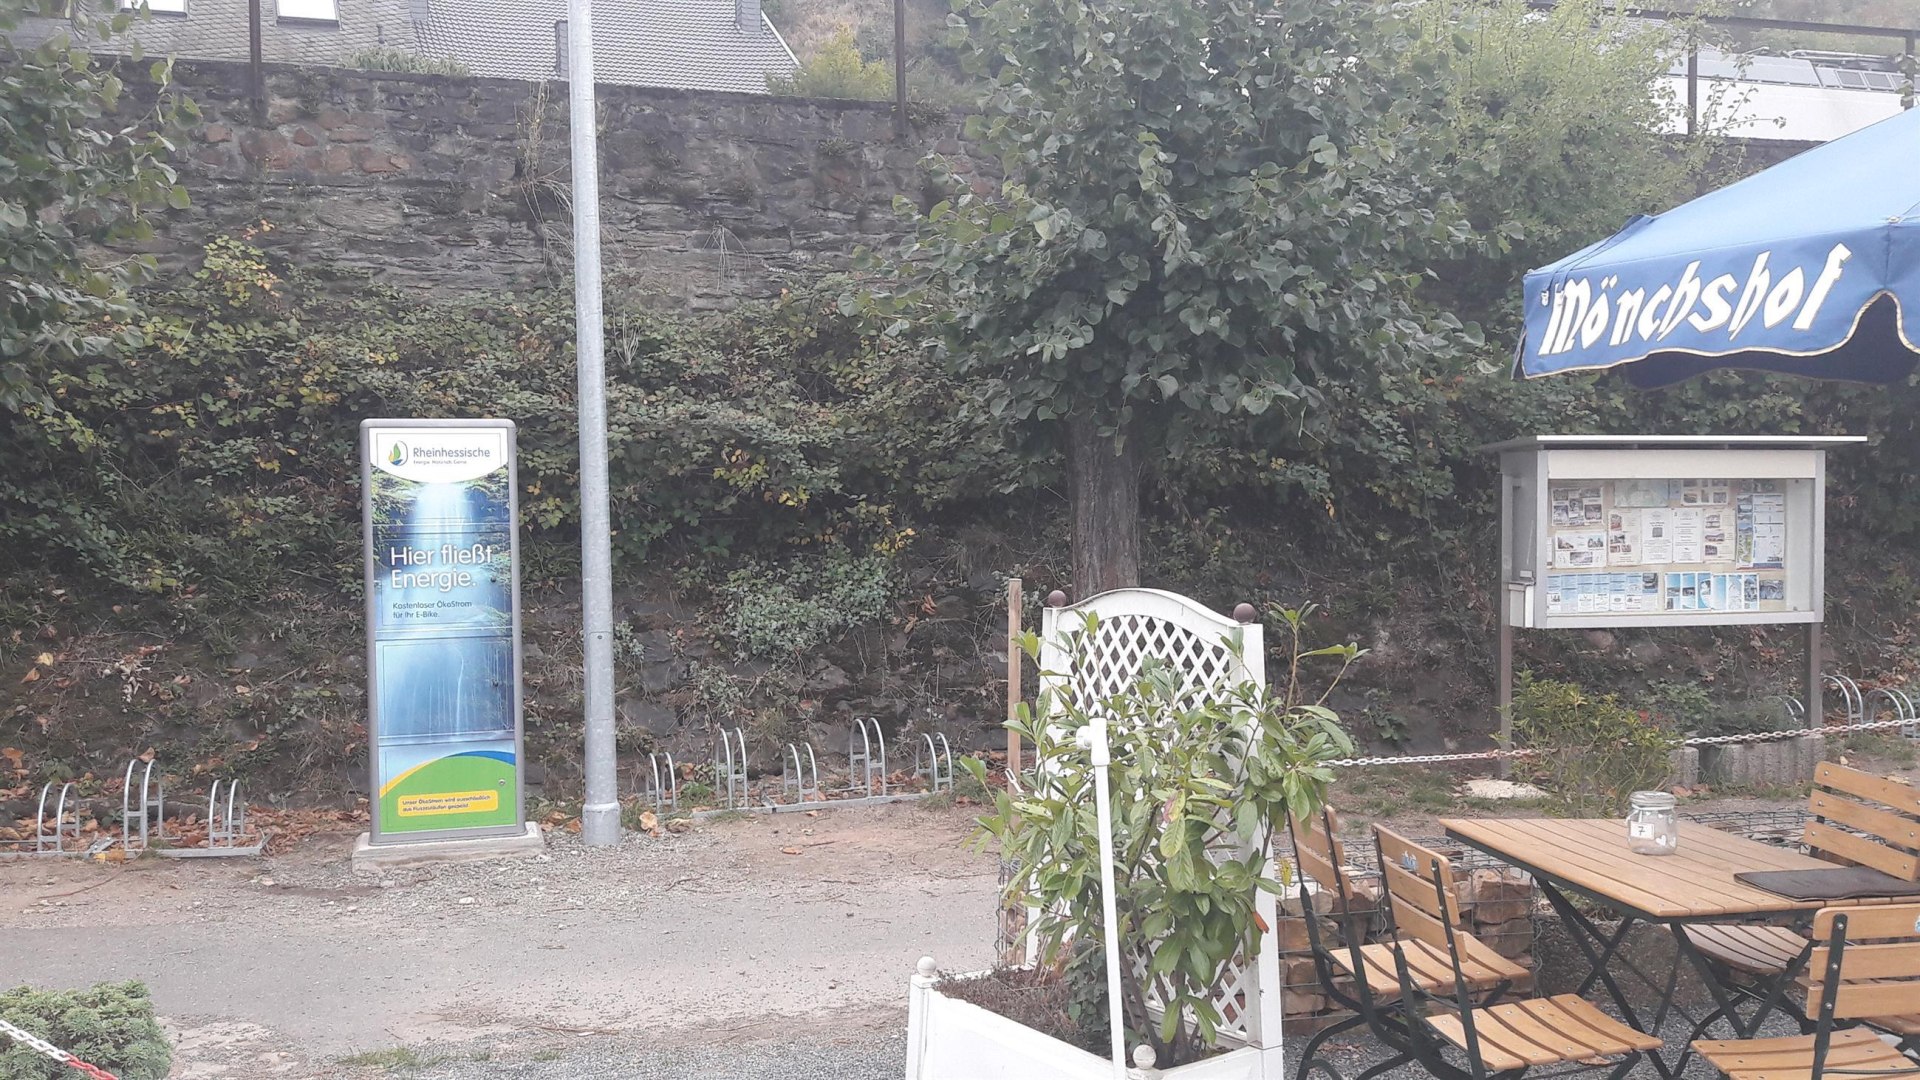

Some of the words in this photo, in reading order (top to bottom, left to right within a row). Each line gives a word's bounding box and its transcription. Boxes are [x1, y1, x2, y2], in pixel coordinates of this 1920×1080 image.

[1537, 242, 1852, 355] Mönchshof
[413, 447, 491, 458] Rheinhessische
[390, 546, 435, 566] Hier
[441, 543, 492, 565] fließt
[391, 568, 477, 592] Energie.
[436, 600, 472, 608] ÖkoStrom
[1638, 826, 1645, 836] 7
